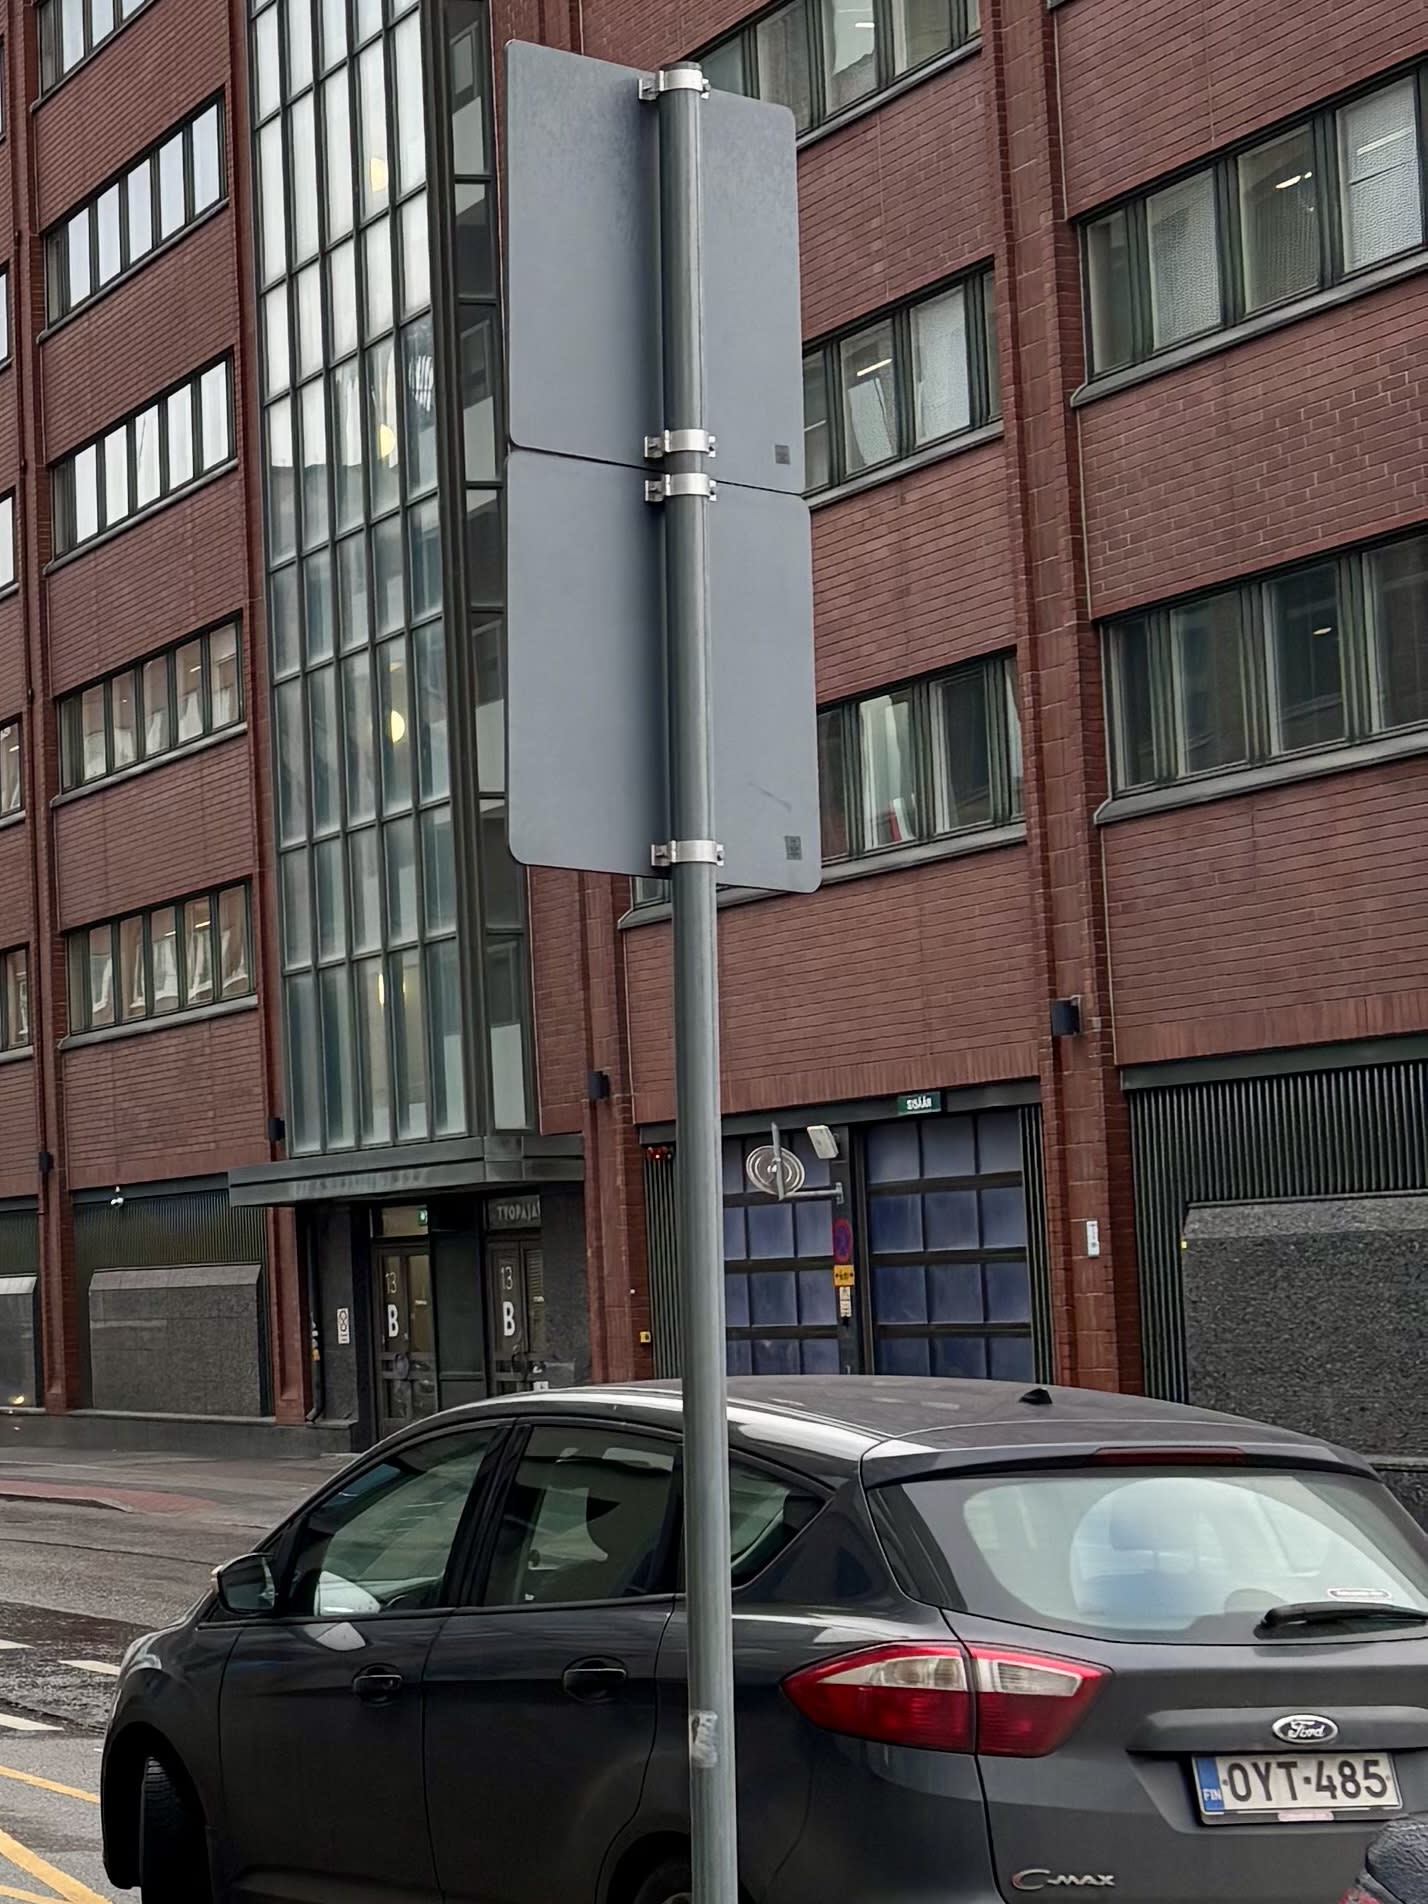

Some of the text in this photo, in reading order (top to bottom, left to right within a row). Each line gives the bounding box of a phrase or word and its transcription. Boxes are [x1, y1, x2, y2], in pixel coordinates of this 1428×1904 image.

[385, 1271, 397, 1294] 13
[501, 1266, 513, 1290] 13
[387, 1304, 399, 1337] B
[503, 1301, 516, 1337] B
[1287, 1720, 1326, 1739] Ford
[1203, 1758, 1389, 1802] FIN OYT-485
